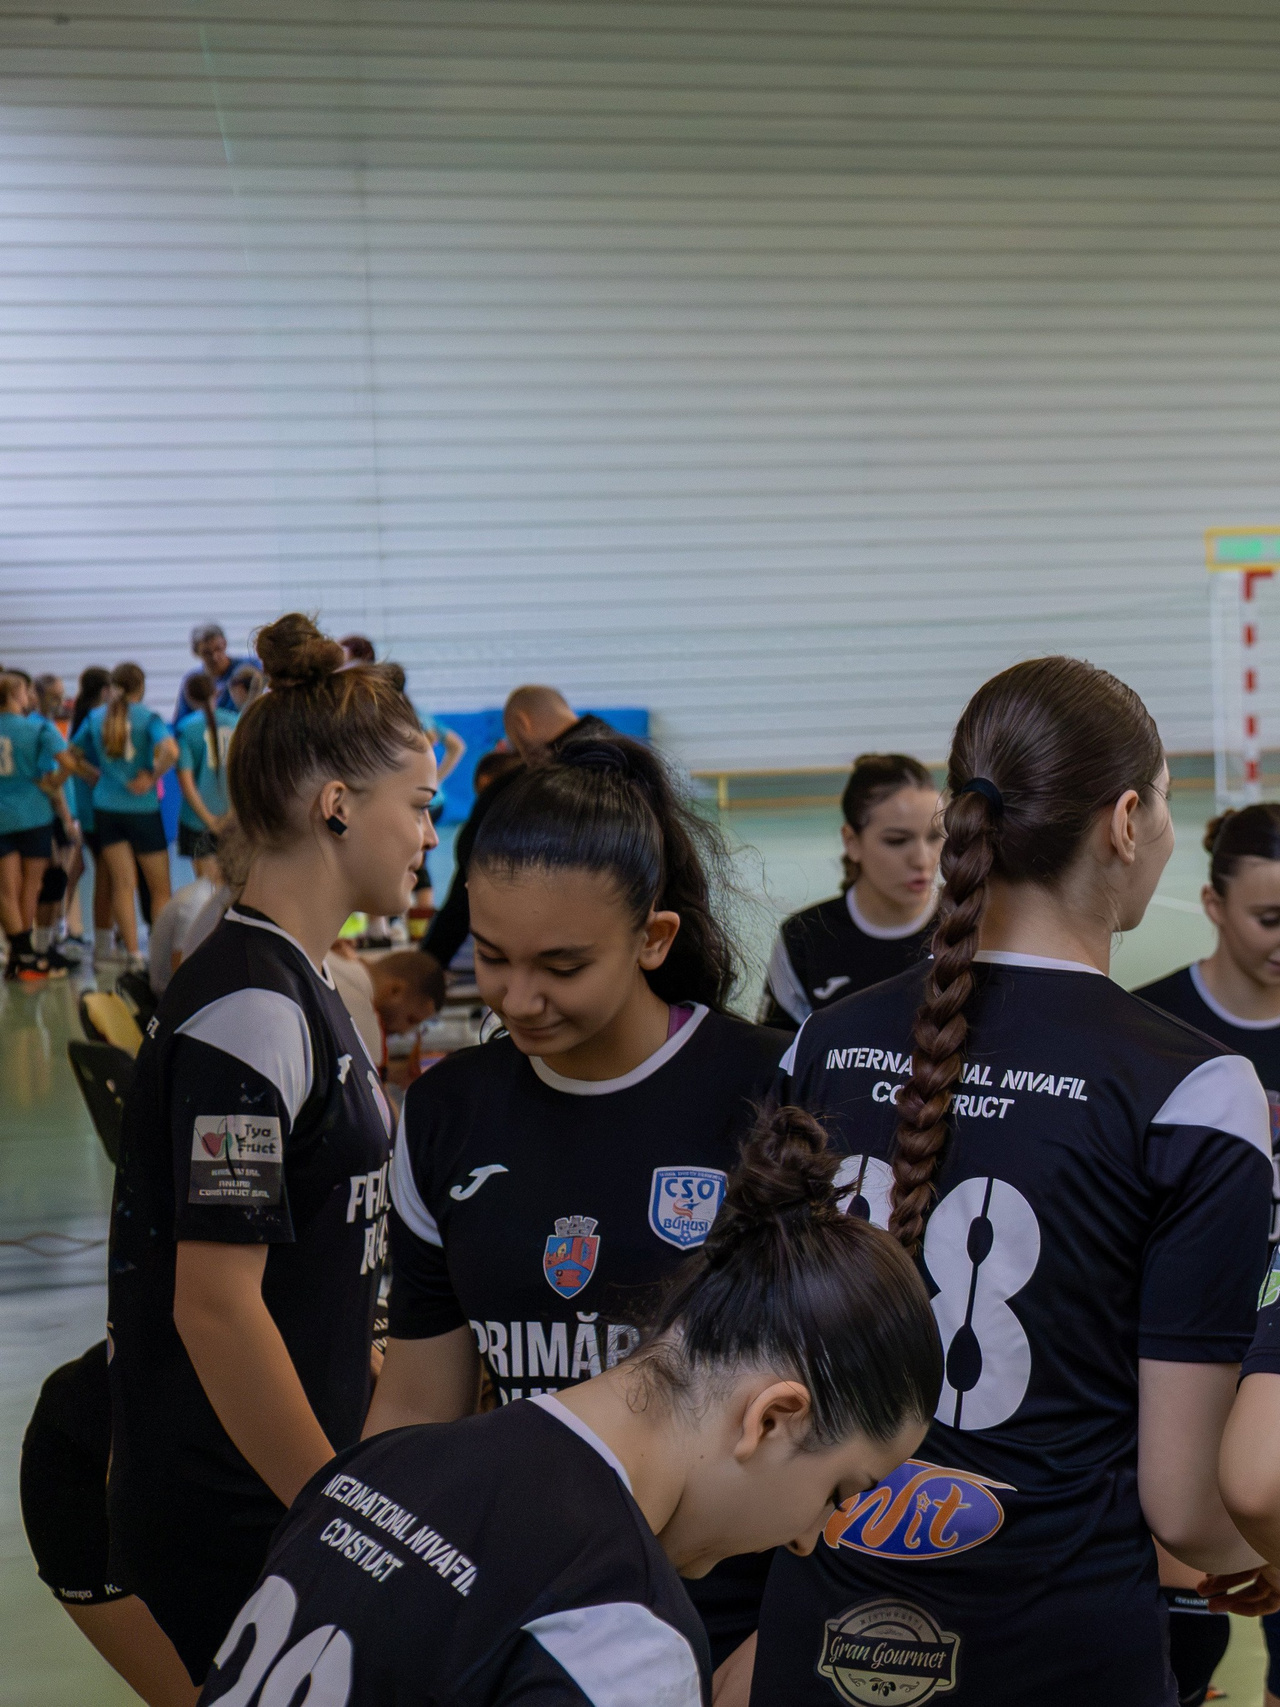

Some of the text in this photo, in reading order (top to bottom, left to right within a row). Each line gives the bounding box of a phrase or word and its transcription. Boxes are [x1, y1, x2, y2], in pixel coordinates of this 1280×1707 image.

[1000, 1069, 1088, 1102] NIVAFIL
[244, 1124, 272, 1140] Tya
[664, 1178, 716, 1200] CSO
[828, 1636, 947, 1670] Gran Gourmet
